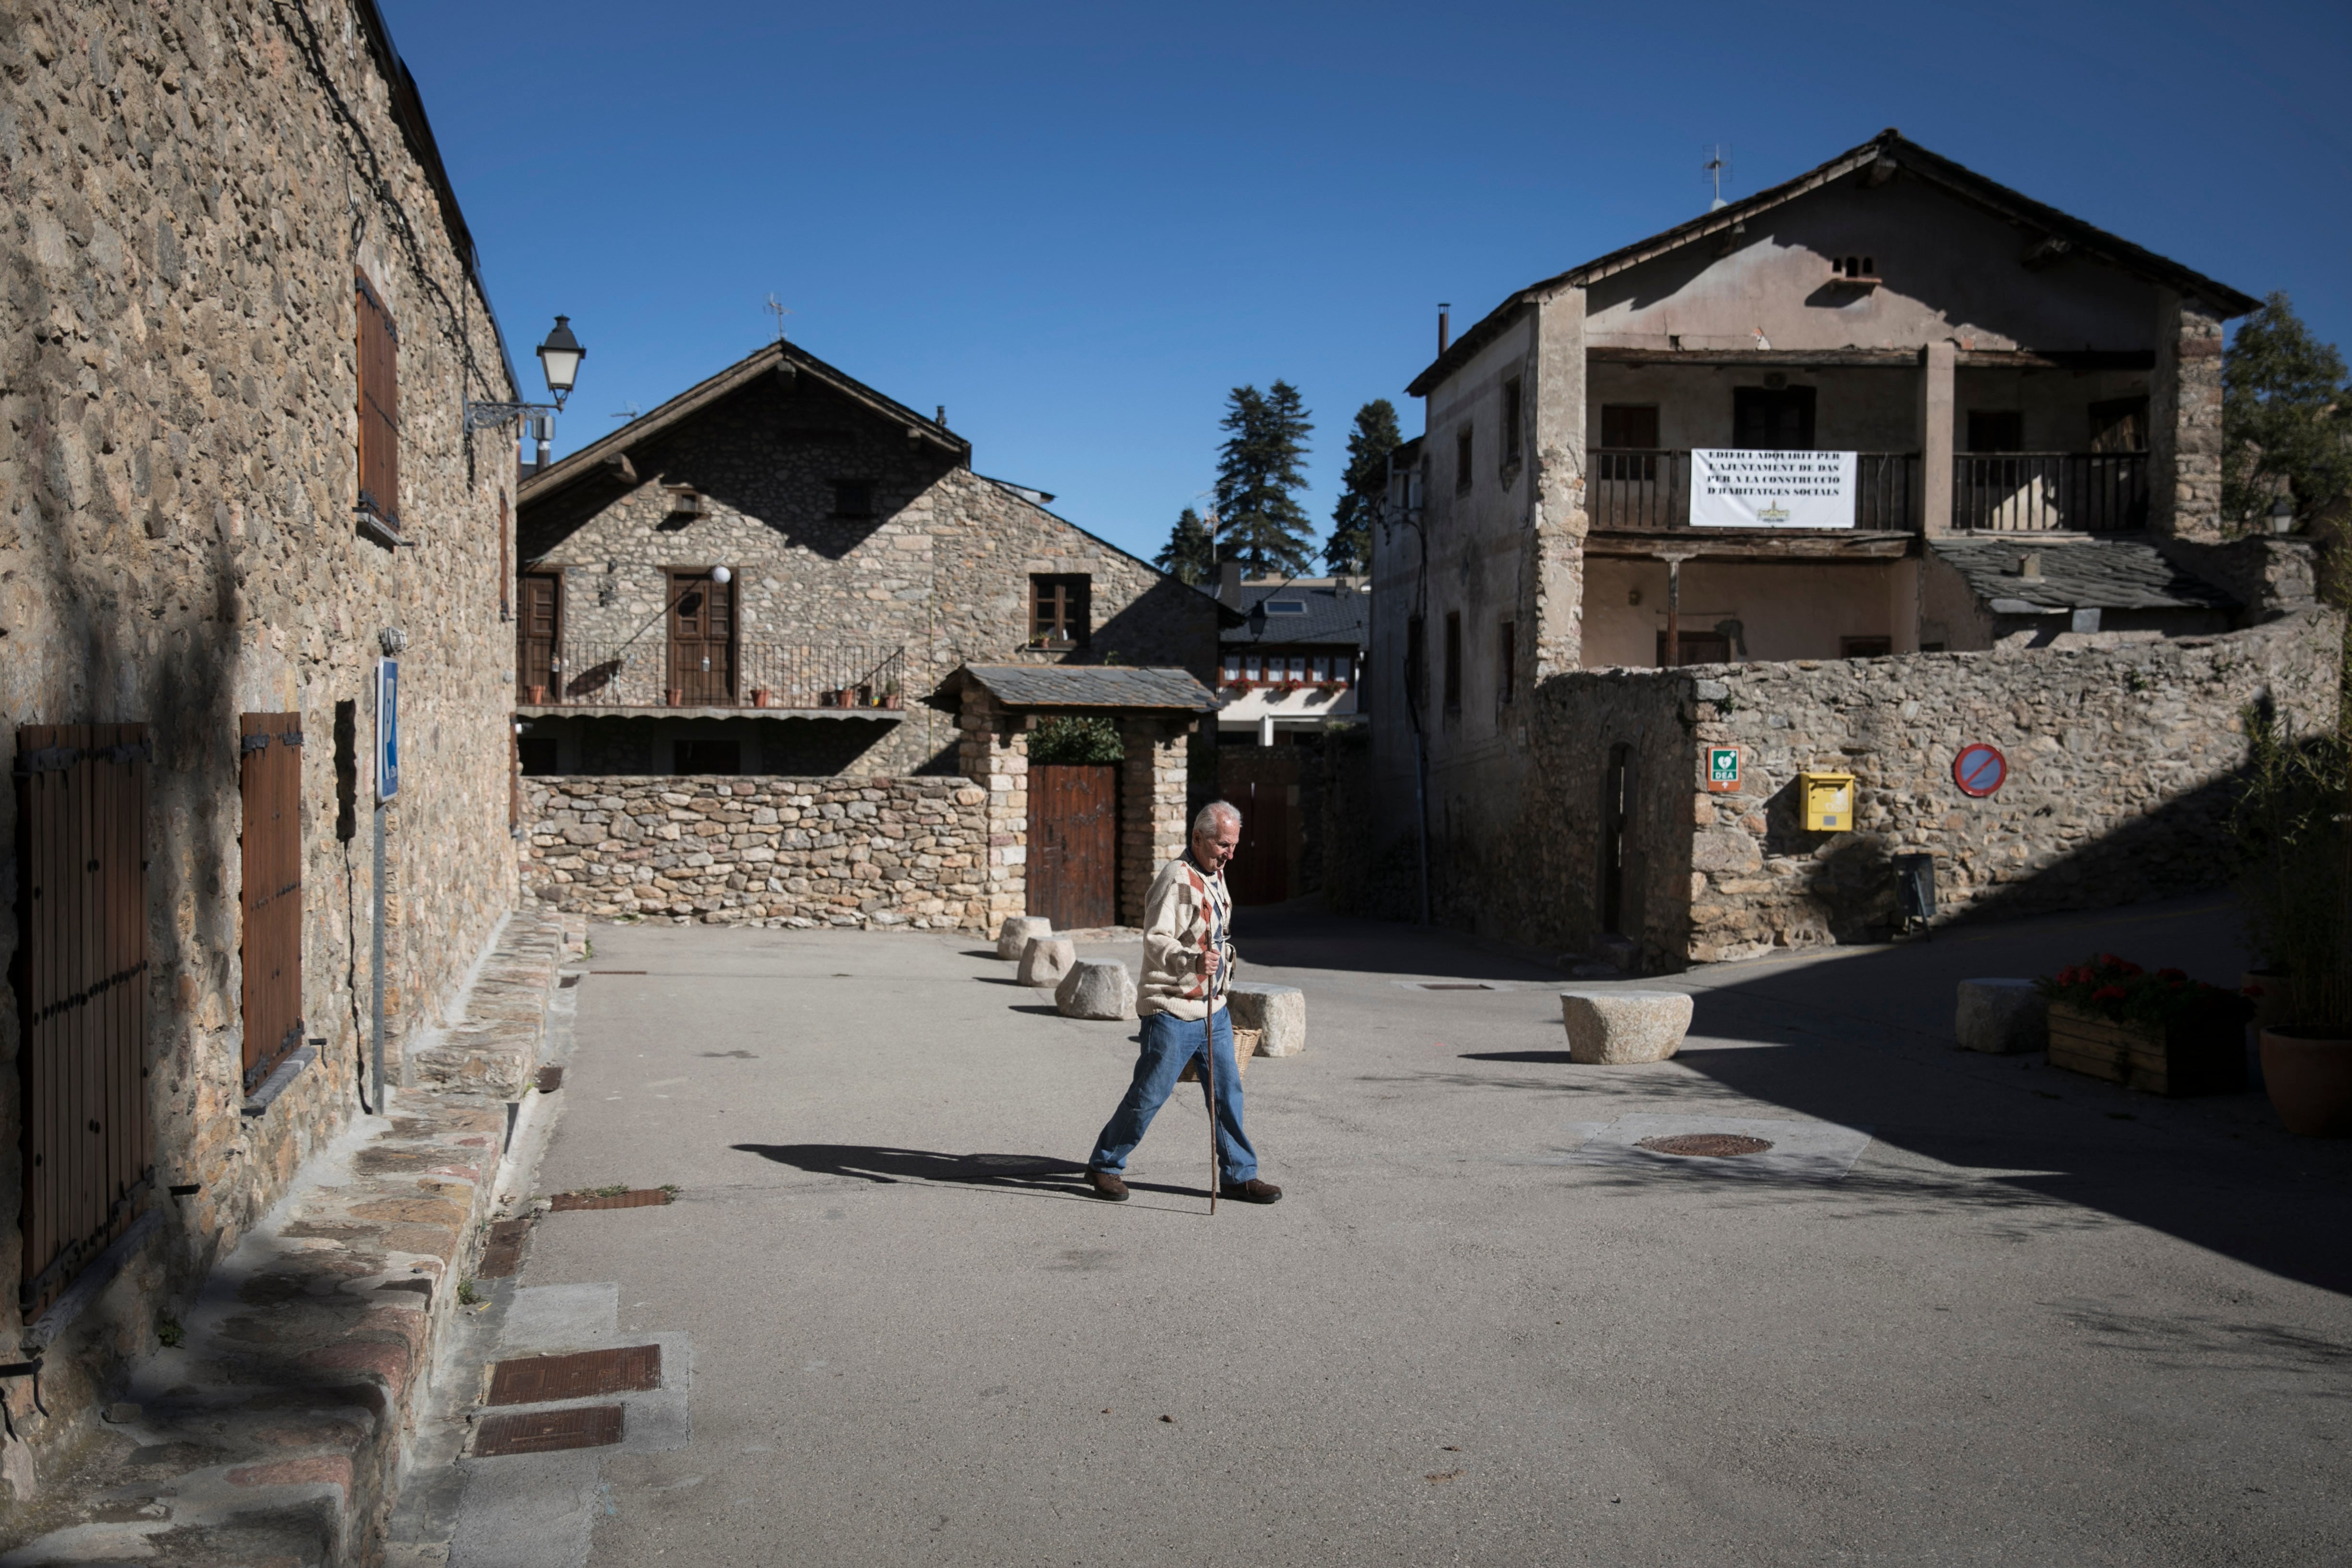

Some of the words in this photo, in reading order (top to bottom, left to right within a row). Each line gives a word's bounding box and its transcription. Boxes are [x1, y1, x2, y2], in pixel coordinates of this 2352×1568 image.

[1756, 453, 1812, 461] ADQUIRIT
[1709, 463, 1794, 472] L'AJUNTAMENT
[1708, 487, 1790, 496] D'HABITATGES
[385, 678, 395, 780] P
